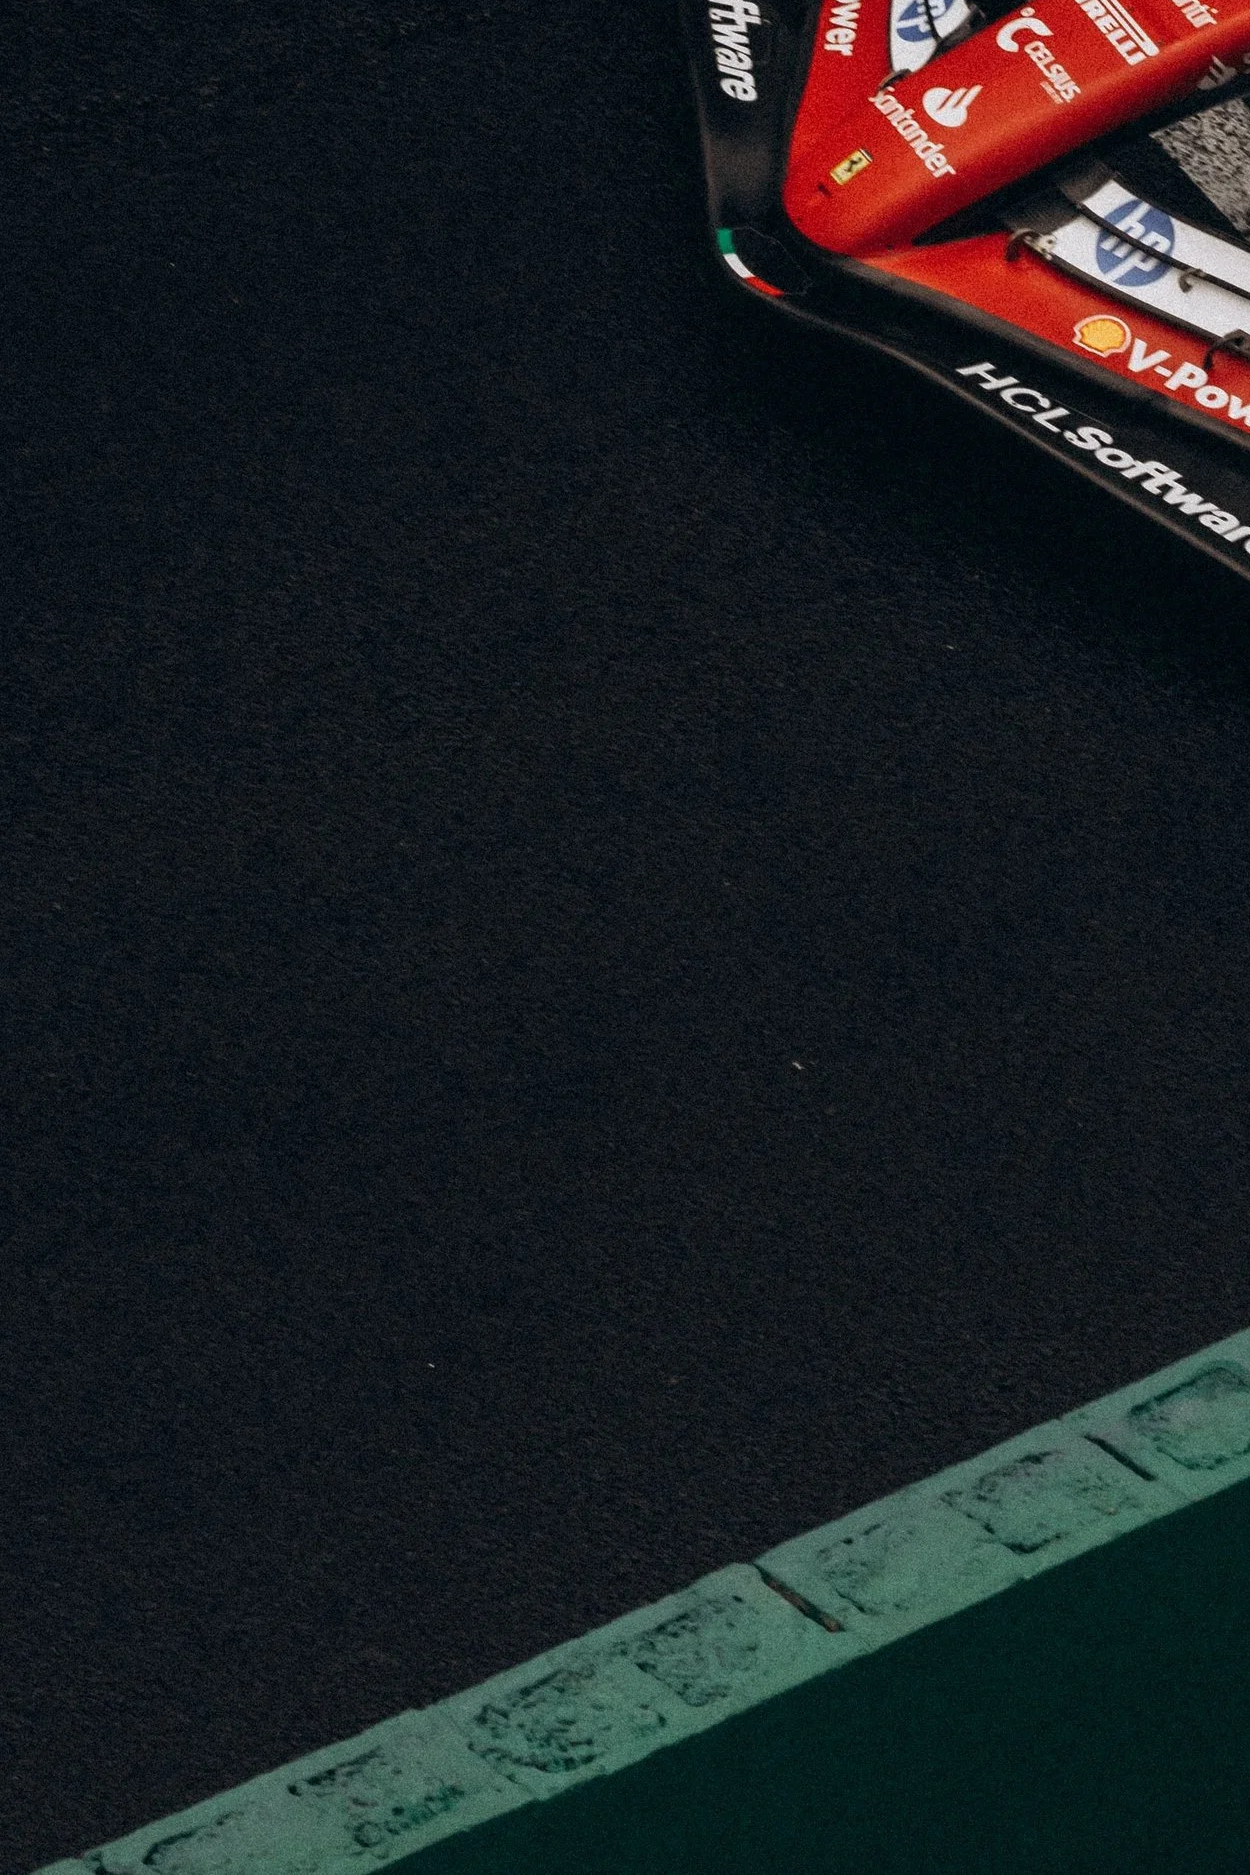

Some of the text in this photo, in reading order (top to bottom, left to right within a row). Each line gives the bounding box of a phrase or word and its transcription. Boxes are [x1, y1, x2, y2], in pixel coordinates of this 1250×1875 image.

[1023, 40, 1082, 104] CELSIUS
[867, 85, 957, 178] Santander
[1098, 200, 1172, 282] hp
